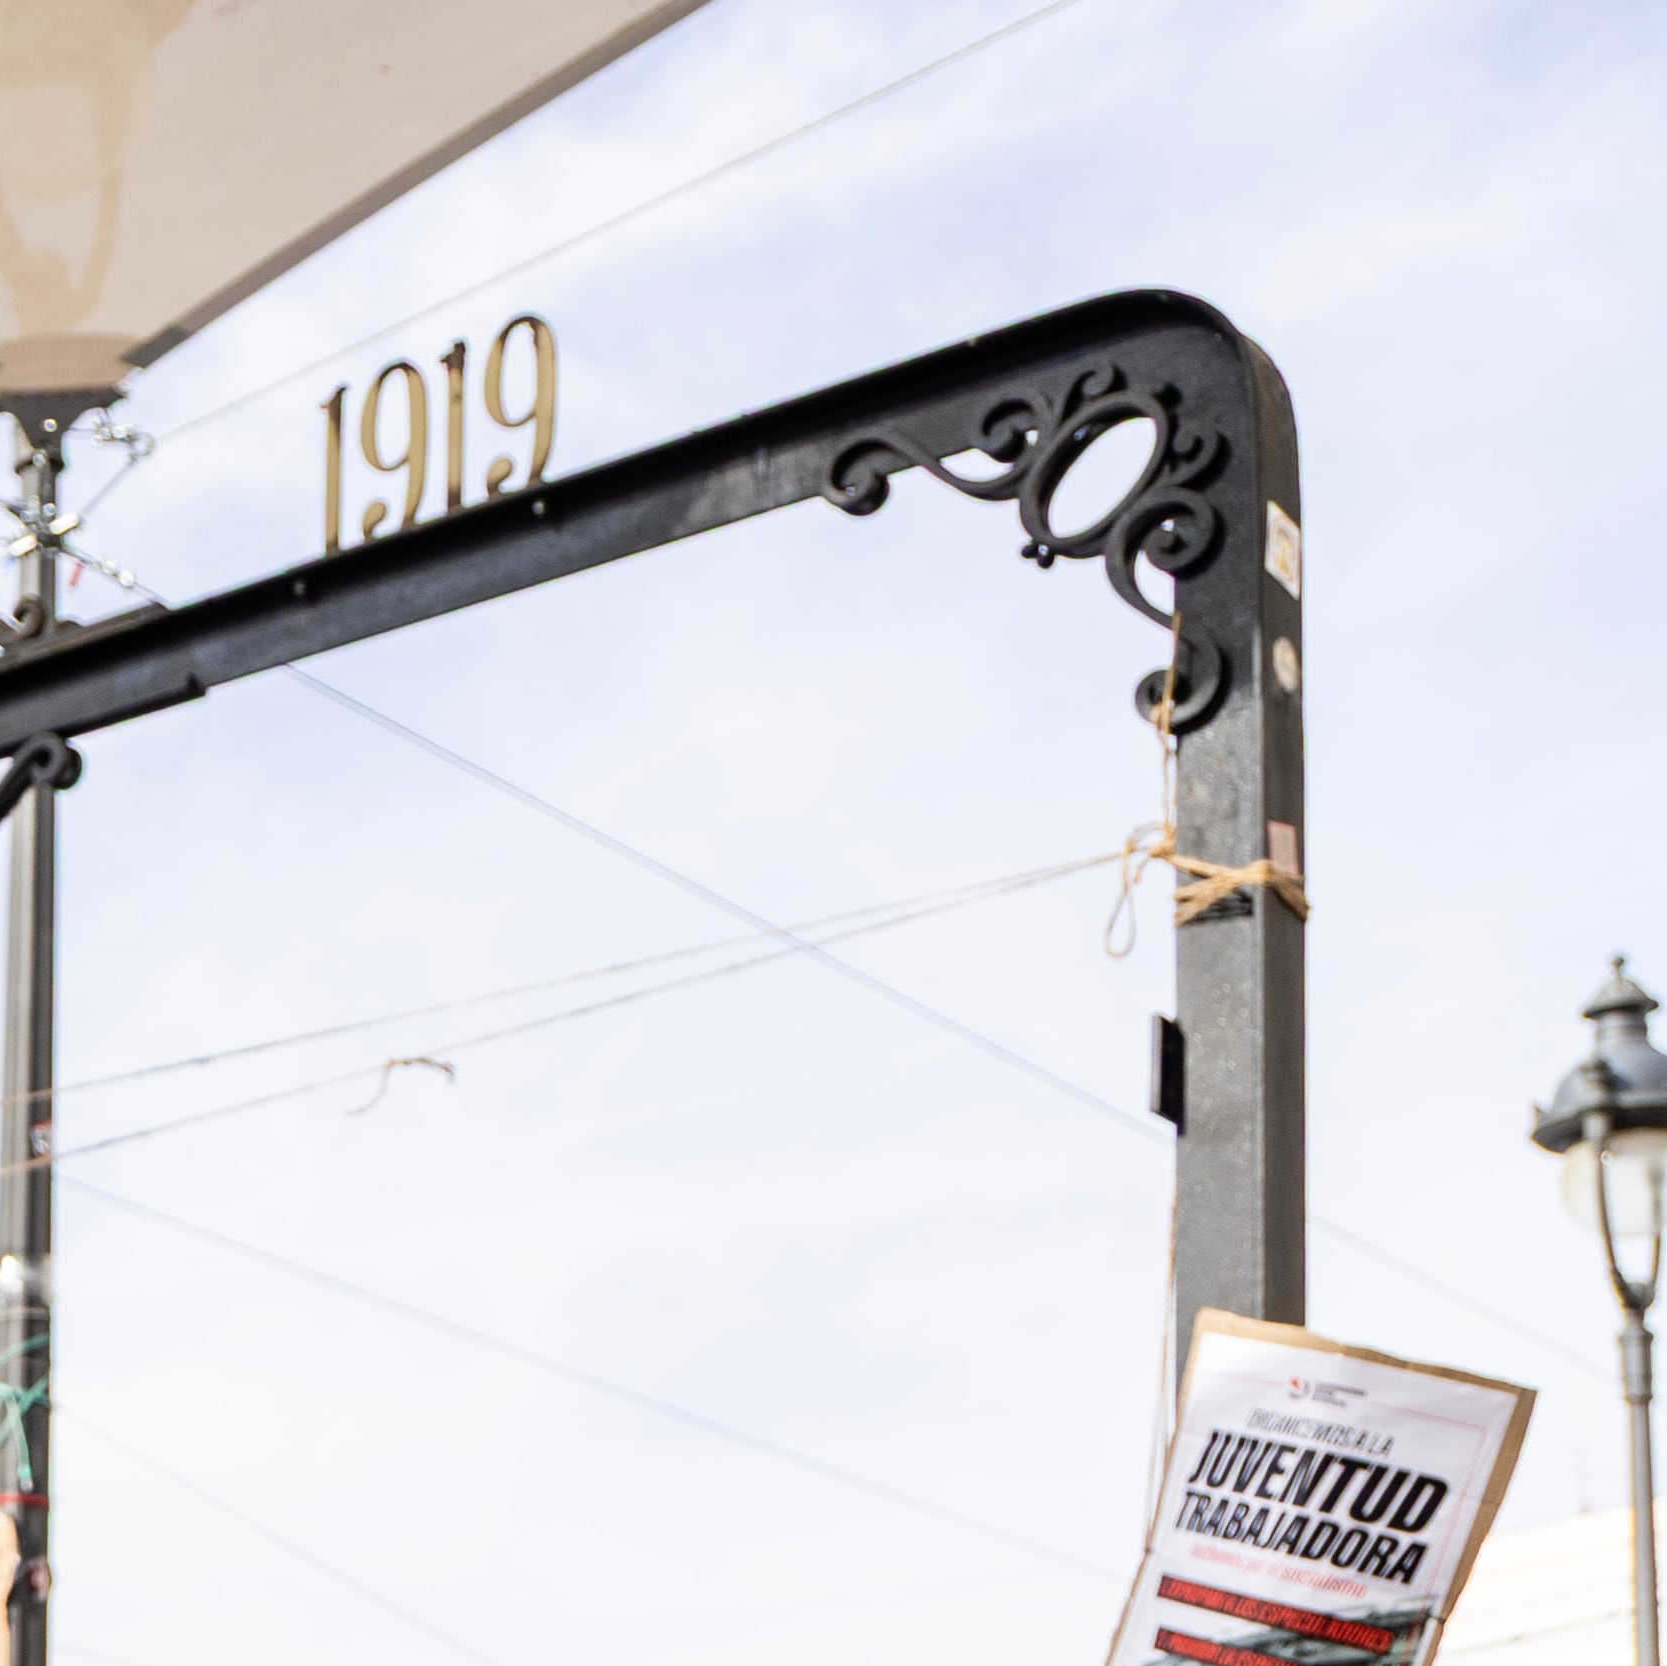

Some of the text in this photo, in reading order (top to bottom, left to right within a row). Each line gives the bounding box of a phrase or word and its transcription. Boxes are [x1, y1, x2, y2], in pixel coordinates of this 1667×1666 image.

[319, 314, 558, 557] 1919
[1175, 1487, 1428, 1585] TRABAJADORA
[1188, 1426, 1451, 1537] JUVENTUD
